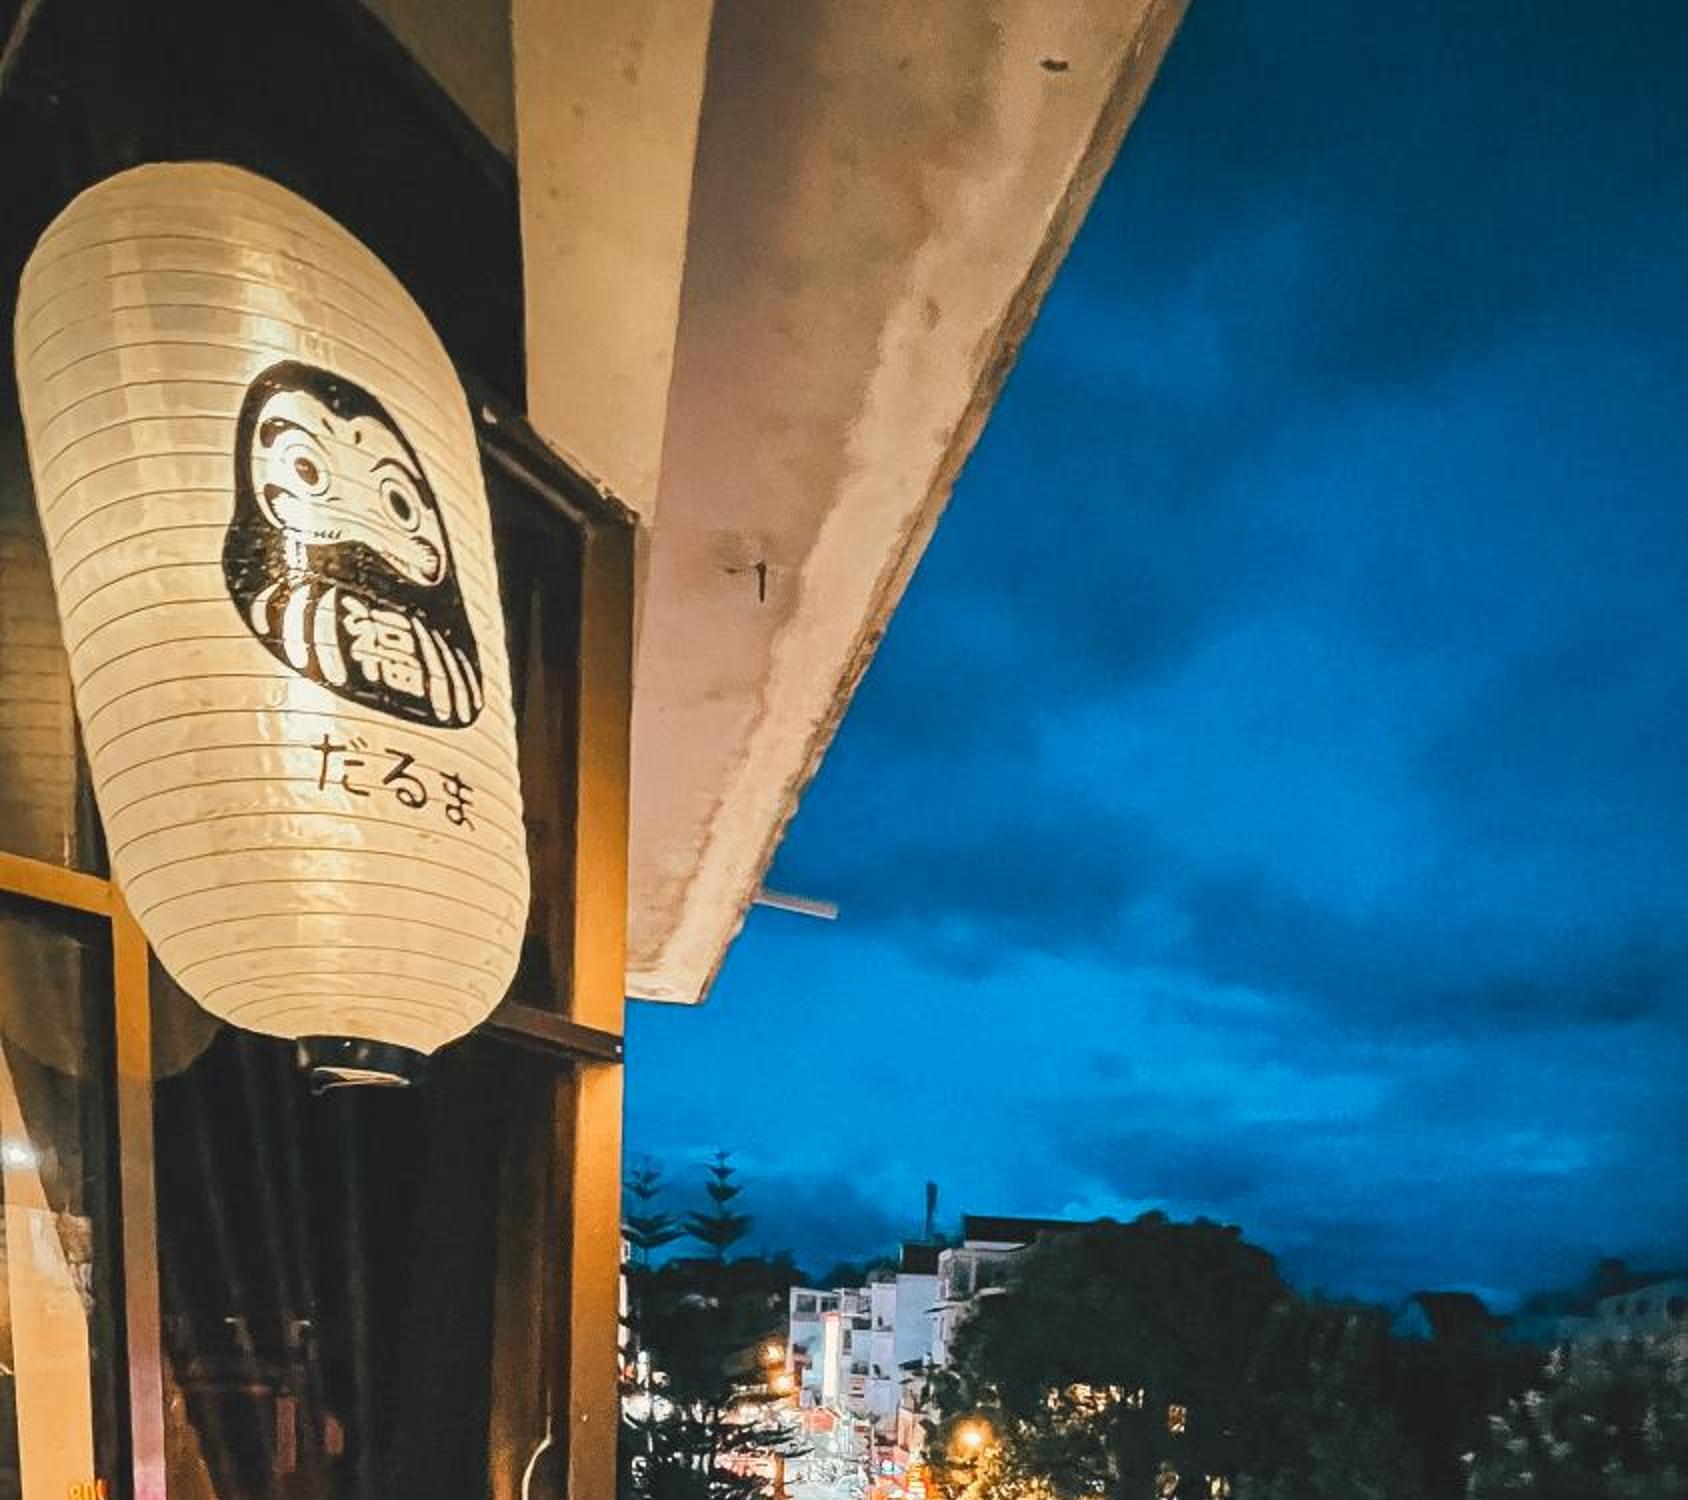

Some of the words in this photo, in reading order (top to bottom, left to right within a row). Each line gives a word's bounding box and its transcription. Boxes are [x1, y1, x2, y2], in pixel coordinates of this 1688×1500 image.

[341, 595, 425, 698] 福
[311, 733, 476, 832] だるま
